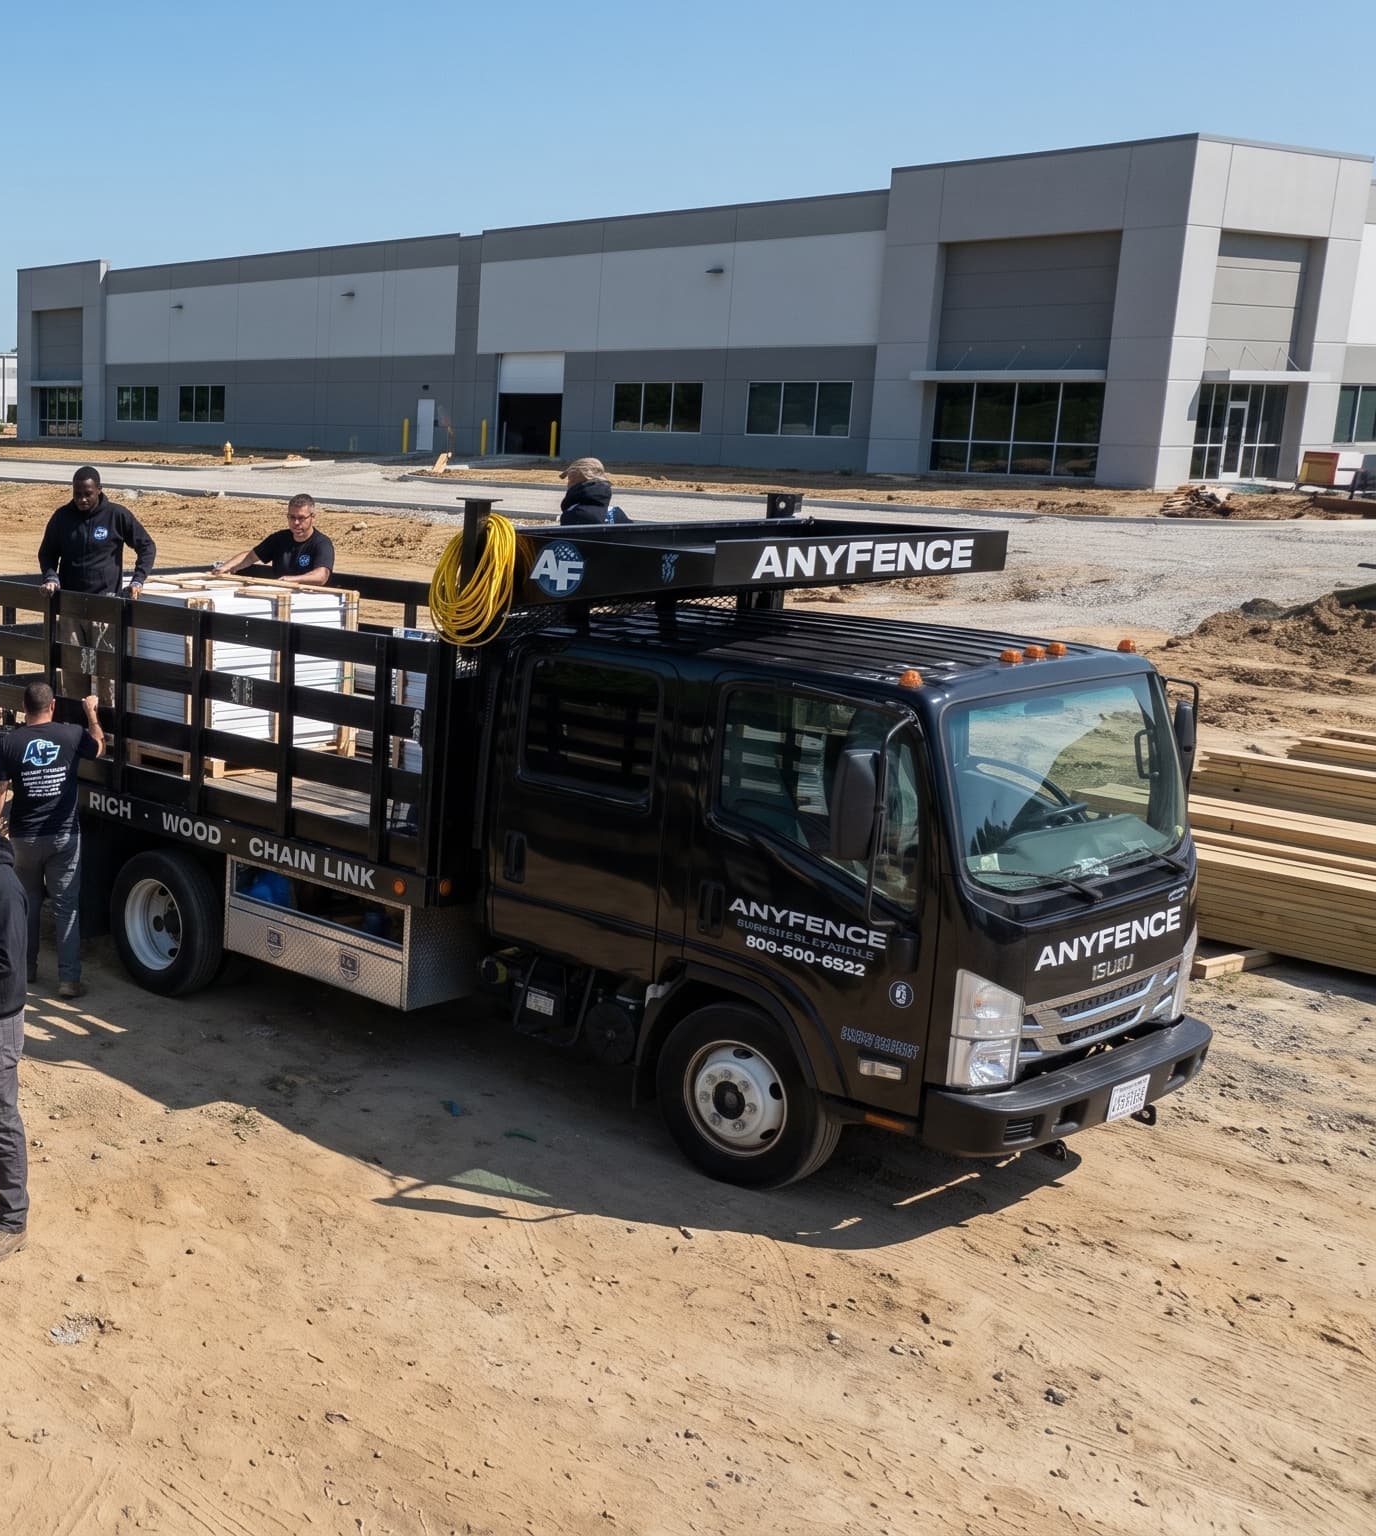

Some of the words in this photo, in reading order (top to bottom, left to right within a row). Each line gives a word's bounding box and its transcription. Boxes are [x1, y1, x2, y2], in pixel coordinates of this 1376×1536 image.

[529, 549, 585, 591] AF
[751, 538, 975, 580] ANYFENCE
[89, 791, 132, 820] RICH
[162, 811, 222, 845] WOOD
[249, 837, 316, 873] CHAIN
[323, 857, 376, 890] LINK
[728, 897, 887, 950] ANYFENCE
[1034, 905, 1182, 972] ANYFENCE
